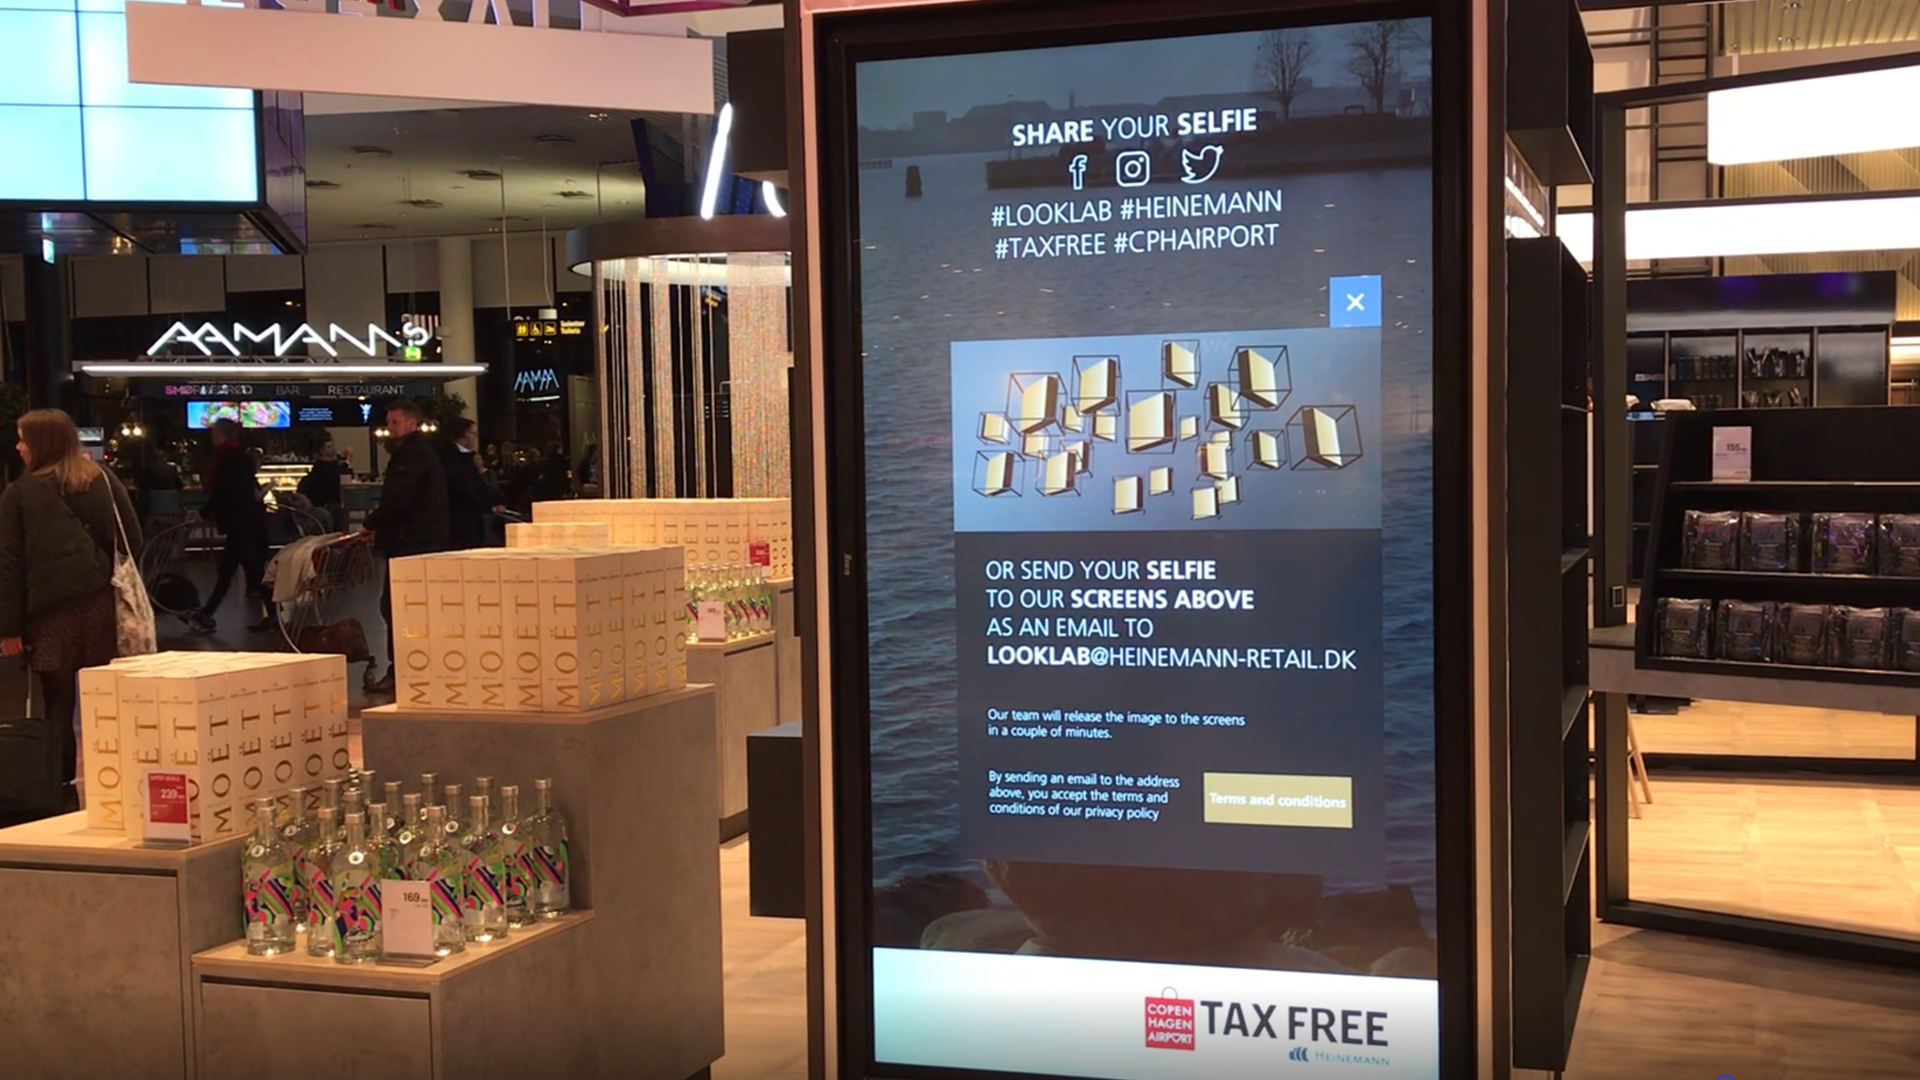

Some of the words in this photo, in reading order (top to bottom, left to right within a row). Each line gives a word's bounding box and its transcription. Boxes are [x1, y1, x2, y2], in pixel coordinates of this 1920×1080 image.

[1013, 120, 1093, 146] SHARE
[1102, 115, 1169, 139] YOUR
[1178, 108, 1256, 135] SELFIE
[992, 200, 1111, 226] #LOOKLAB
[1121, 190, 1281, 219] #HEINEMANN
[995, 233, 1105, 259] #TAXFREE
[1114, 224, 1279, 253] #CPHAIRPORT
[276, 386, 300, 396] BAR
[328, 385, 405, 396] RESTAURANT
[986, 561, 1014, 579] OR
[1021, 561, 1073, 579] SEND
[1080, 561, 1139, 580] YOUR
[1147, 561, 1216, 579] SELFIE
[986, 589, 1013, 608] TO
[1020, 589, 1064, 608] OUR
[1071, 589, 1167, 609] SCREENS
[1174, 590, 1254, 609] ABOVE
[987, 617, 1013, 636] AS
[1019, 618, 1048, 636] AN
[1057, 618, 1119, 637] EMAIL
[1125, 618, 1153, 638] TO
[988, 646, 1356, 669] LOOKLAB@HEINEMANN-RETAIL.DK
[988, 709, 1008, 720] Our
[1012, 711, 1039, 721] team
[1042, 710, 1061, 721] will
[1065, 710, 1102, 722] release
[1105, 711, 1124, 722] the
[1128, 712, 1162, 726] image
[1165, 714, 1177, 724] to
[1181, 713, 1199, 724] the
[1203, 716, 1245, 726] screens
[328, 694, 349, 771] OËT
[989, 724, 998, 735] in
[1002, 727, 1008, 735] a
[1011, 725, 1047, 739] couple
[1050, 725, 1062, 737] of
[1066, 727, 1112, 738] minutes.
[207, 714, 233, 834] MOËT
[989, 770, 1002, 784] By
[1005, 772, 1047, 787] sending
[1050, 775, 1064, 783] an
[1067, 774, 1097, 785] email
[1100, 775, 1112, 785] to
[1116, 774, 1134, 786] the
[1137, 775, 1180, 788] address
[160, 788, 178, 799] 239
[989, 787, 1024, 800] above,
[1028, 790, 1048, 801] you
[1051, 789, 1087, 803] accept
[1090, 789, 1109, 801] the
[1112, 791, 1144, 802] terms
[1146, 792, 1168, 803] and
[1210, 793, 1246, 804] Terms
[1250, 794, 1274, 805] and
[1278, 795, 1346, 808] conditions
[990, 803, 1045, 816] conditions
[1048, 803, 1060, 815] of
[1063, 807, 1082, 816] our
[1085, 806, 1124, 820] privacy
[1127, 807, 1159, 821] policy
[403, 892, 420, 902] 169
[1147, 1003, 1192, 1017] COPEN
[1147, 1017, 1192, 1030] HAGEN
[1200, 1000, 1277, 1038] TAX
[1288, 1006, 1388, 1047] FREE
